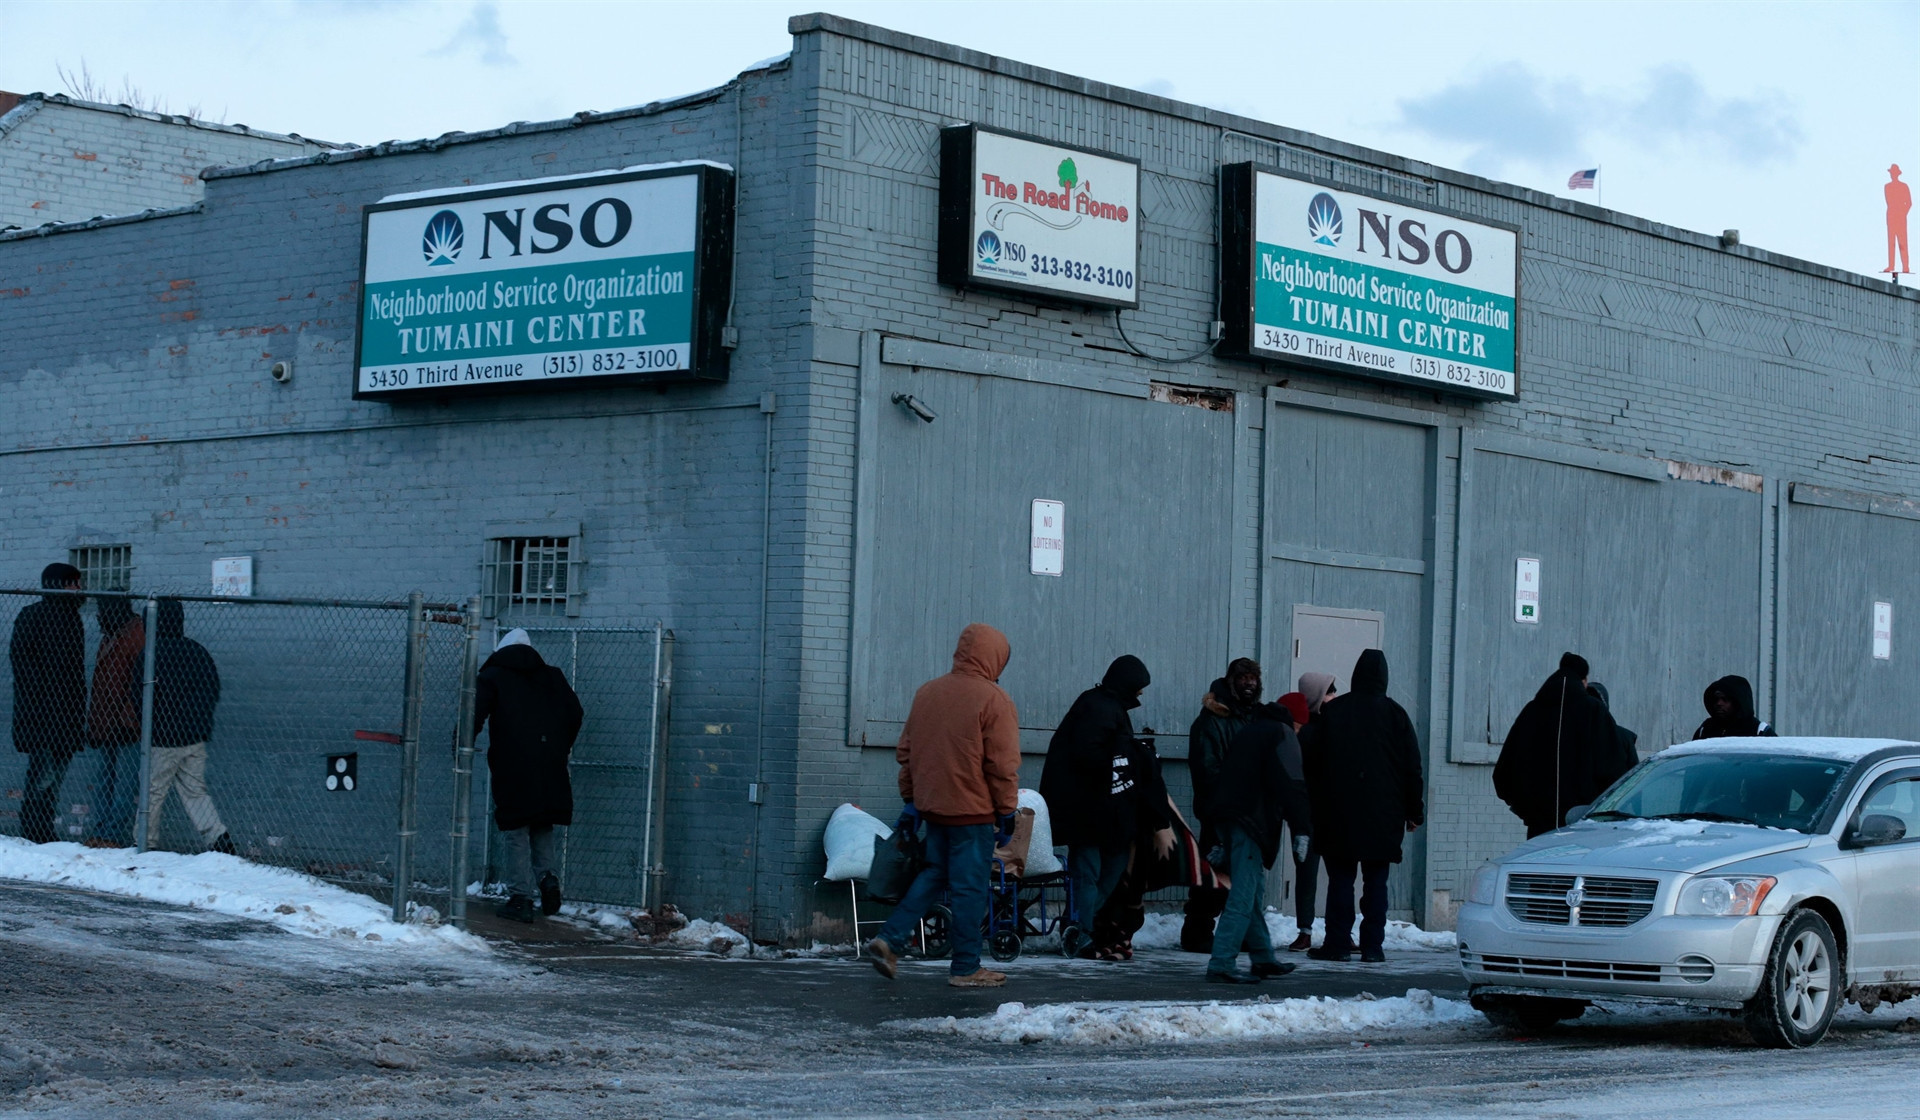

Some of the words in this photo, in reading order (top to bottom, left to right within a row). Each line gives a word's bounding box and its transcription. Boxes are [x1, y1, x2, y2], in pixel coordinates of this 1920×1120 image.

[982, 173, 1017, 200] The
[1023, 180, 1071, 211] Road
[1076, 191, 1128, 222] Home
[479, 197, 633, 260] NSO
[1004, 241, 1026, 262] NSO
[1356, 208, 1473, 274] NSO
[370, 282, 487, 325] Neighborhood
[493, 276, 557, 308] Service
[564, 265, 684, 309] Organization
[1031, 253, 1133, 289] 313-832-3100
[1262, 253, 1366, 300] Neighborhood
[1370, 276, 1422, 312] Service
[1425, 288, 1510, 330] Organization
[398, 320, 514, 355] TUMAINI
[527, 308, 647, 344] CENTER
[1289, 296, 1388, 339] TUMAINI
[1398, 318, 1487, 359] CENTER
[369, 363, 408, 388] 3430
[416, 362, 458, 385] Third
[464, 362, 524, 380] Avenue
[543, 354, 584, 377] (313)
[593, 348, 678, 372] 832-3100
[1263, 330, 1299, 351] 3430
[1306, 337, 1342, 359] Third
[1347, 346, 1395, 369] Avenue
[1410, 355, 1441, 379] (313)
[1447, 364, 1506, 390] 832-3100
[1033, 537, 1061, 551] LOITERING
[1043, 516, 1053, 527] NO
